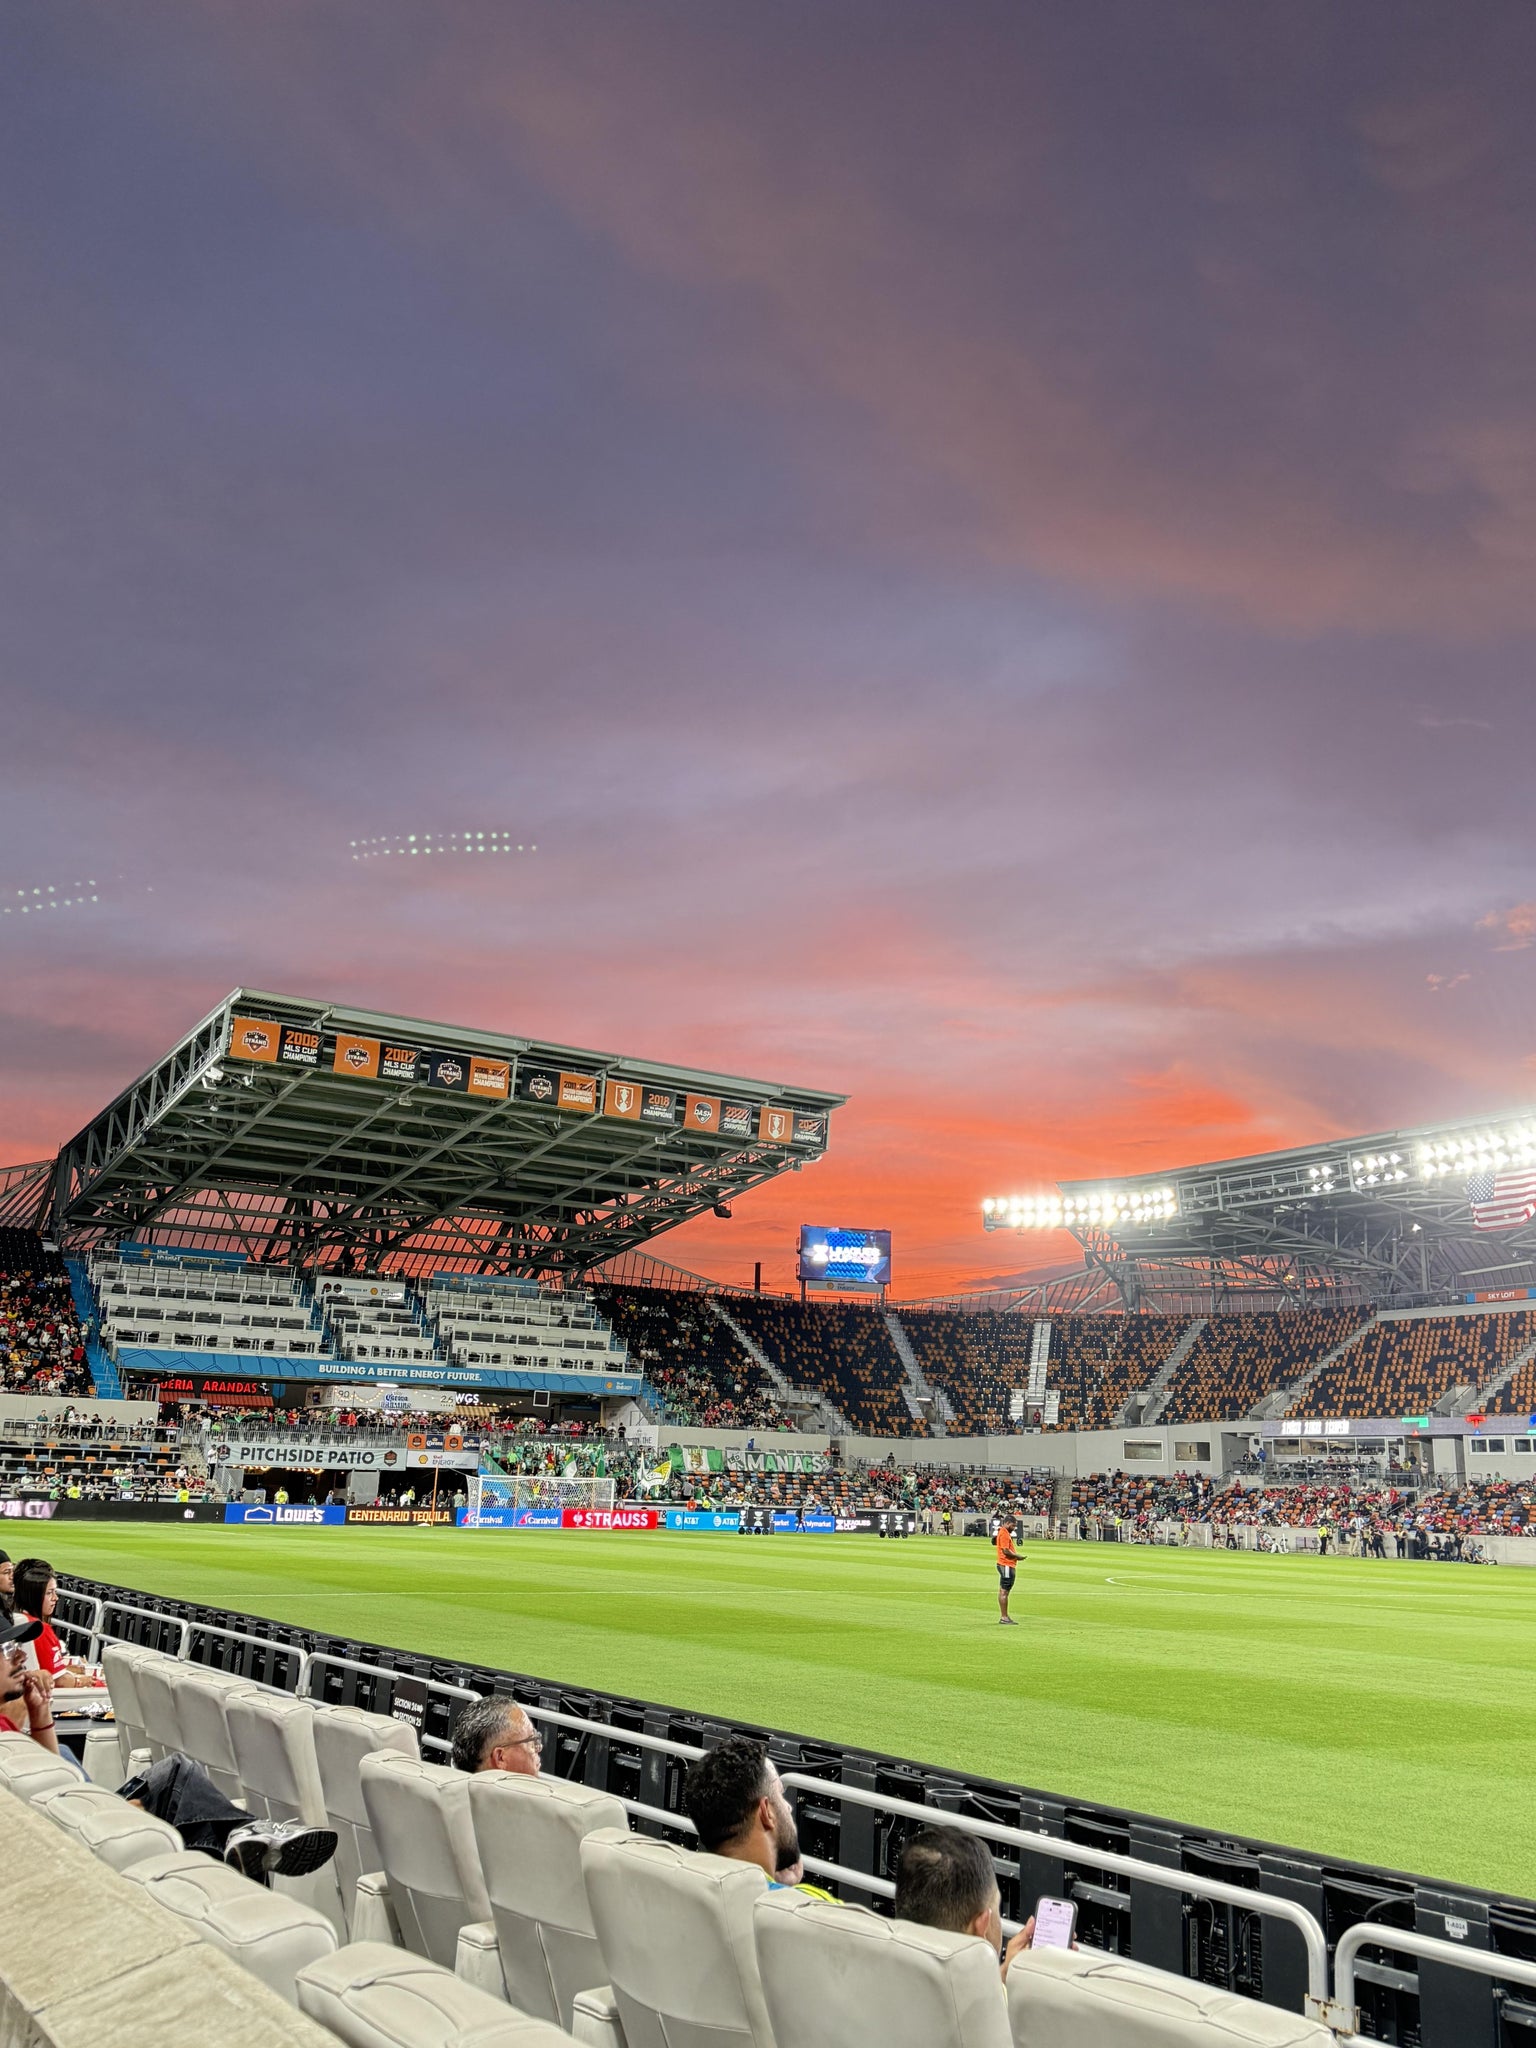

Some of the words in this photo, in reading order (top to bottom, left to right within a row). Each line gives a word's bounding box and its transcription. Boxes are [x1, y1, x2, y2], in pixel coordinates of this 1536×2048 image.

[285, 1030, 319, 1048] 2006
[284, 1043, 301, 1052] MLS
[301, 1047, 318, 1056] CUP
[384, 1047, 417, 1063] 2007
[282, 1051, 317, 1064] CHAMPIONS
[383, 1060, 399, 1069] MLS
[400, 1062, 415, 1070] CUP
[382, 1067, 415, 1079] CHAMPIONS
[648, 1093, 670, 1108] 2018
[642, 1108, 673, 1119] CHAMPIONS
[1501, 1291, 1516, 1299] LOFT
[318, 1364, 366, 1375] BUILDING
[367, 1367, 375, 1375] A
[376, 1369, 408, 1377] BETTER
[409, 1371, 446, 1380] ENERGY
[446, 1373, 483, 1381] FUTURE.
[202, 1380, 257, 1394] ARANDAS
[240, 1447, 323, 1463] PITCHSIDE
[327, 1451, 375, 1464] PATIO
[747, 1453, 821, 1473] MANIACS
[276, 1507, 325, 1522] LOWE'S
[349, 1510, 410, 1522] CENTENARIO
[526, 1515, 559, 1525] Carnival
[585, 1512, 648, 1526] STRAUSS
[722, 1517, 738, 1526] AT&T
[394, 1697, 411, 1710] SECTION
[411, 1702, 417, 1712] 24
[398, 1711, 415, 1725] SECTION
